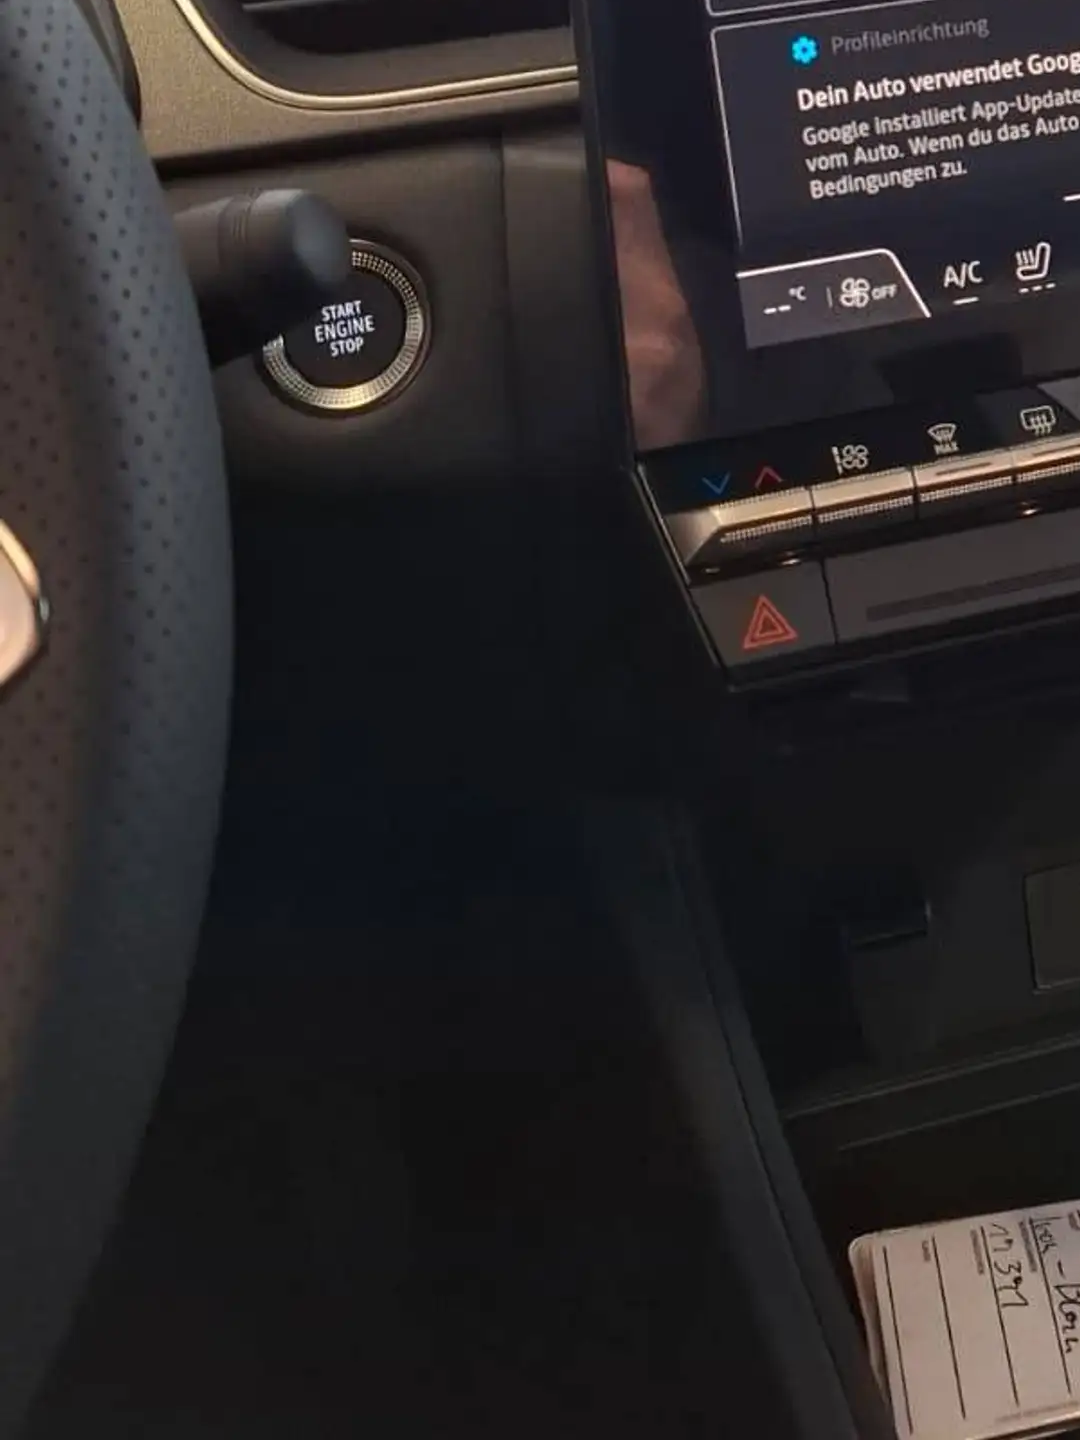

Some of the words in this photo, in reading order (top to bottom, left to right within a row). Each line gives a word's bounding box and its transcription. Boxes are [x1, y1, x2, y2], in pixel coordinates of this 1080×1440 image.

[830, 18, 990, 54] Profileinrichtung
[797, 86, 849, 111] Dein
[853, 78, 906, 103] Auto
[909, 57, 1024, 93] verwendet
[803, 121, 870, 146] Google
[874, 105, 968, 135] installiert
[805, 152, 848, 173] vom
[853, 144, 904, 166] Auto.
[908, 133, 964, 156] Wenn
[968, 127, 993, 147] du
[997, 120, 1031, 142] das
[1035, 113, 1080, 137] Auto
[809, 163, 937, 200] Bedingungen
[941, 160, 968, 178] zu.
[943, 261, 984, 289] A/C
[872, 284, 898, 301] OFF
[321, 300, 362, 322] START
[314, 315, 375, 343] ENGINE
[330, 337, 364, 357] STOP
[933, 442, 959, 455] MAX
